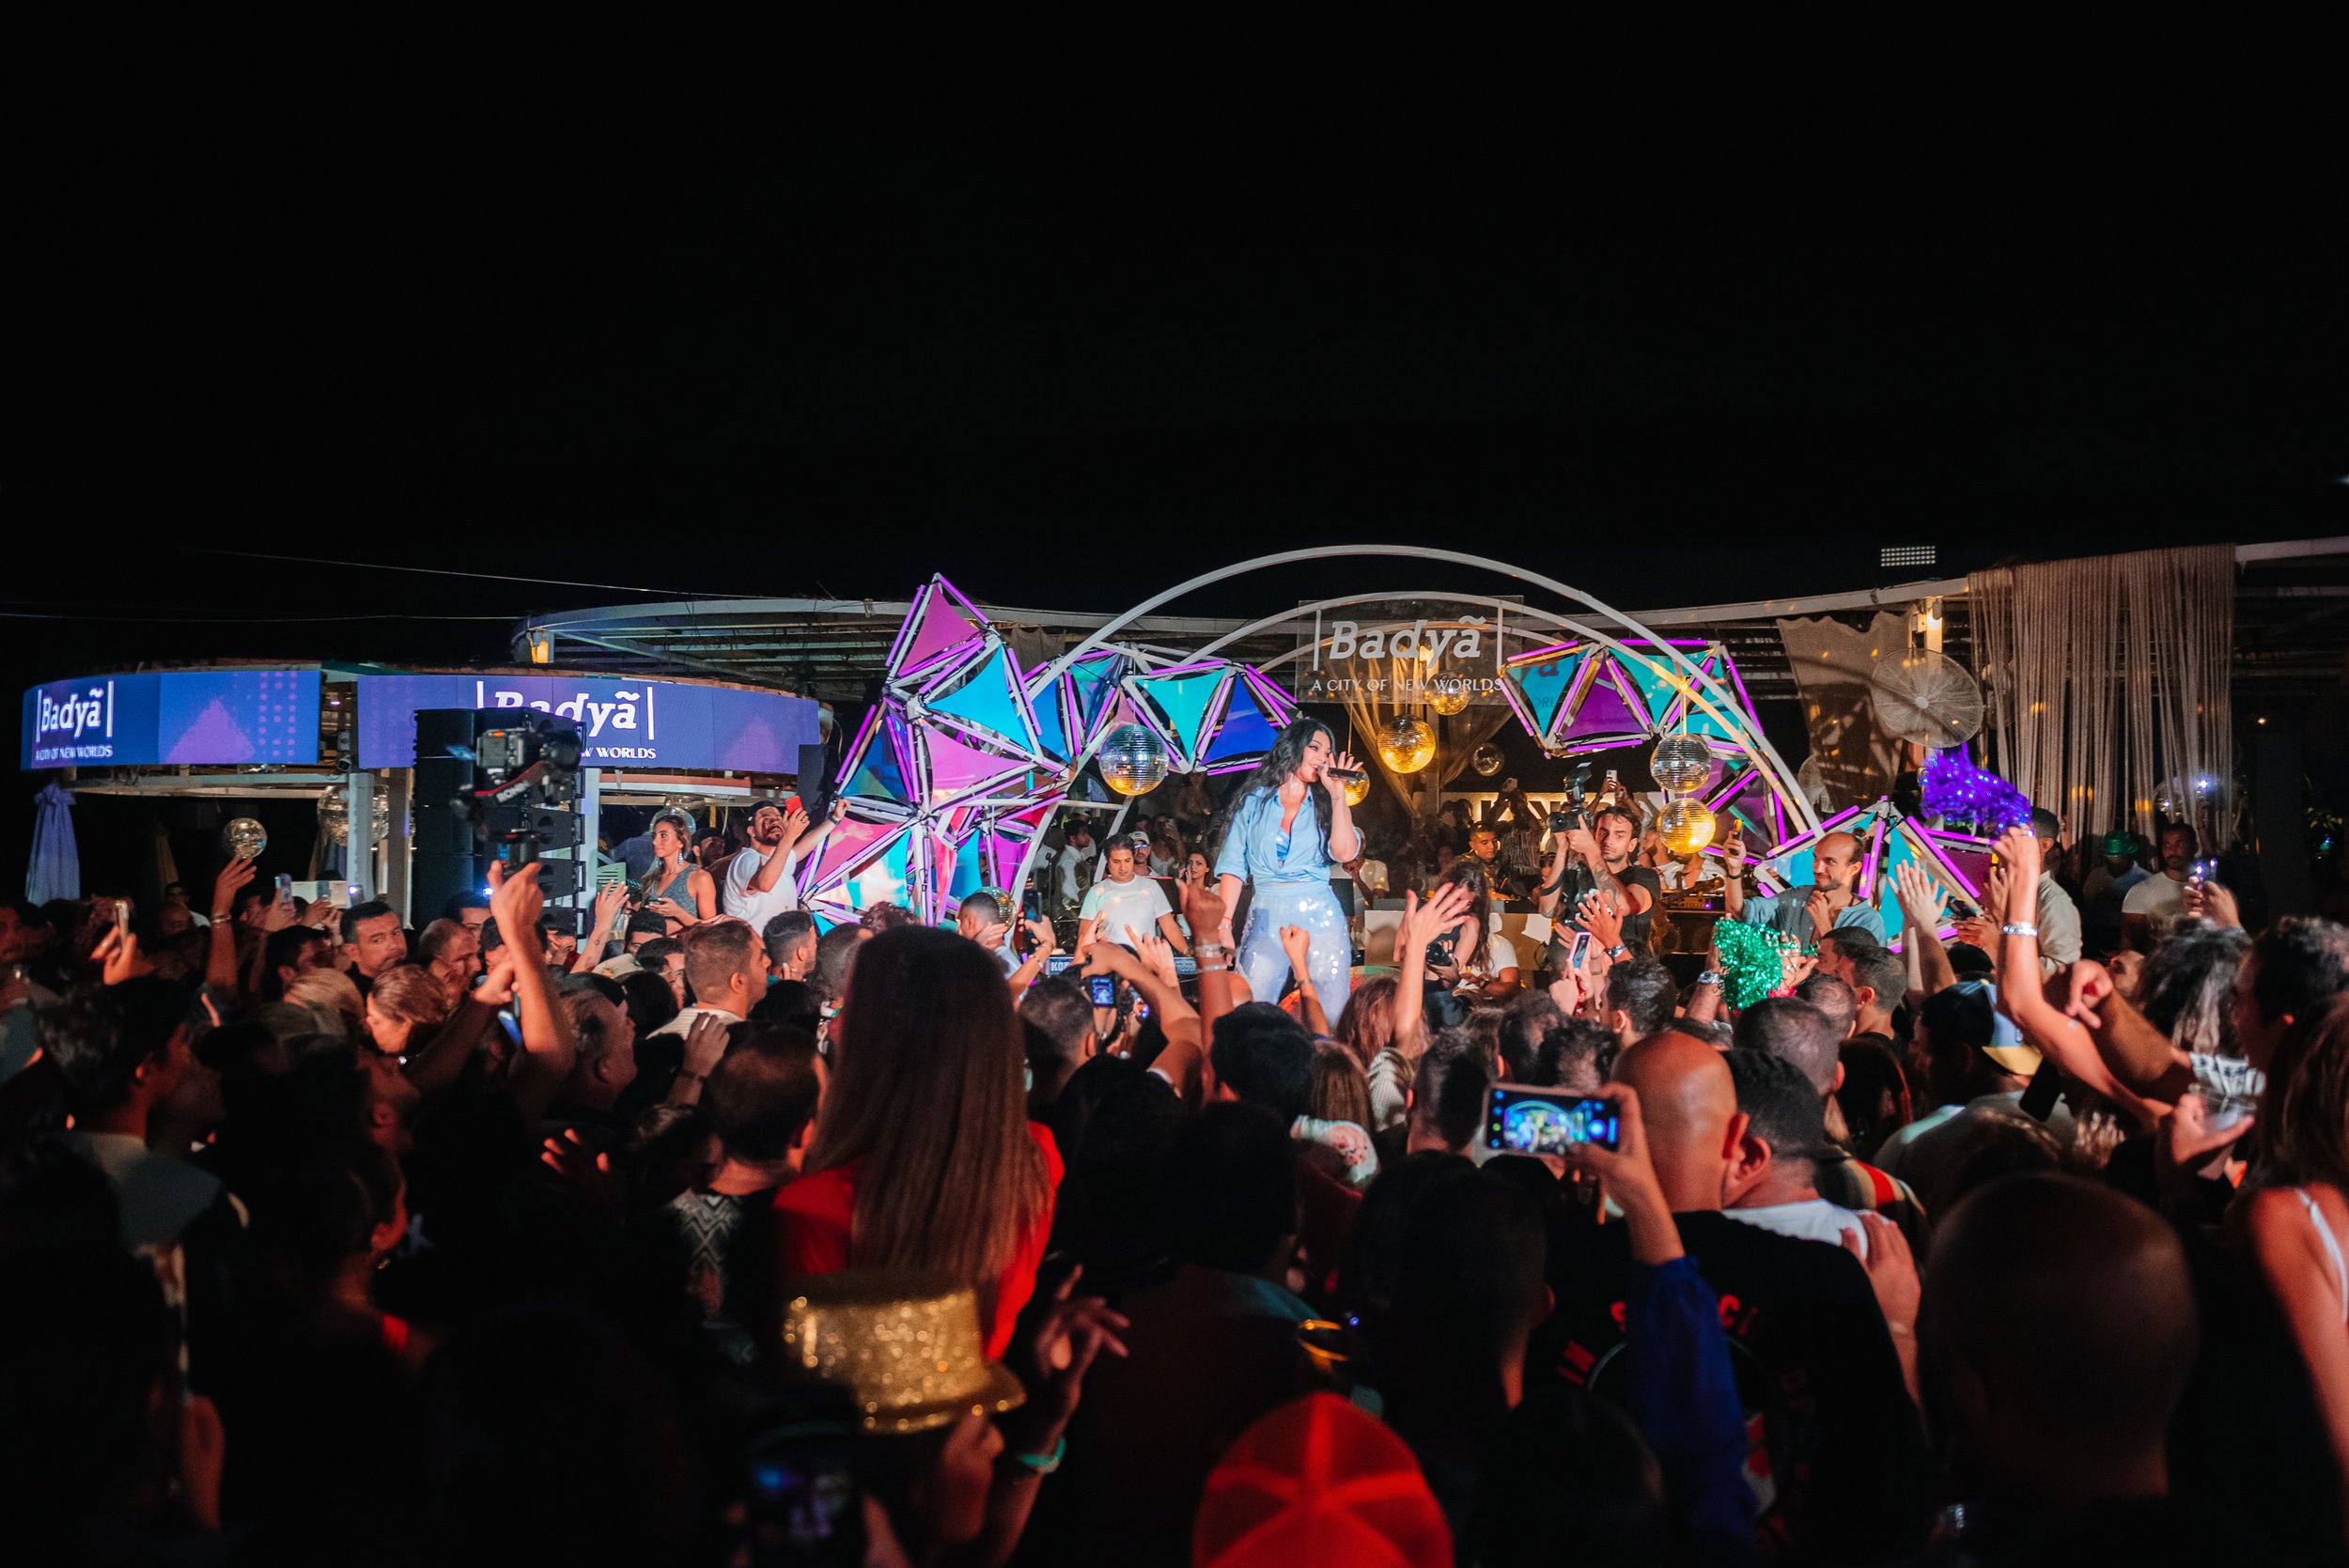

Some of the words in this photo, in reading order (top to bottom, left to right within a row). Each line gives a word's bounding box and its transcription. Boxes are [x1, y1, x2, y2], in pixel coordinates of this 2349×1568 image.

[1329, 615, 1486, 668] Badyã
[1312, 679, 1322, 691] A
[1327, 679, 1361, 691] CITY
[1367, 679, 1388, 691] OF
[1393, 679, 1427, 691] NEW
[1434, 678, 1503, 691] WORLDS
[41, 689, 103, 737] Badyã
[60, 747, 76, 758] NEW
[77, 745, 113, 757] WORLDS
[596, 747, 657, 759] WORLDS
